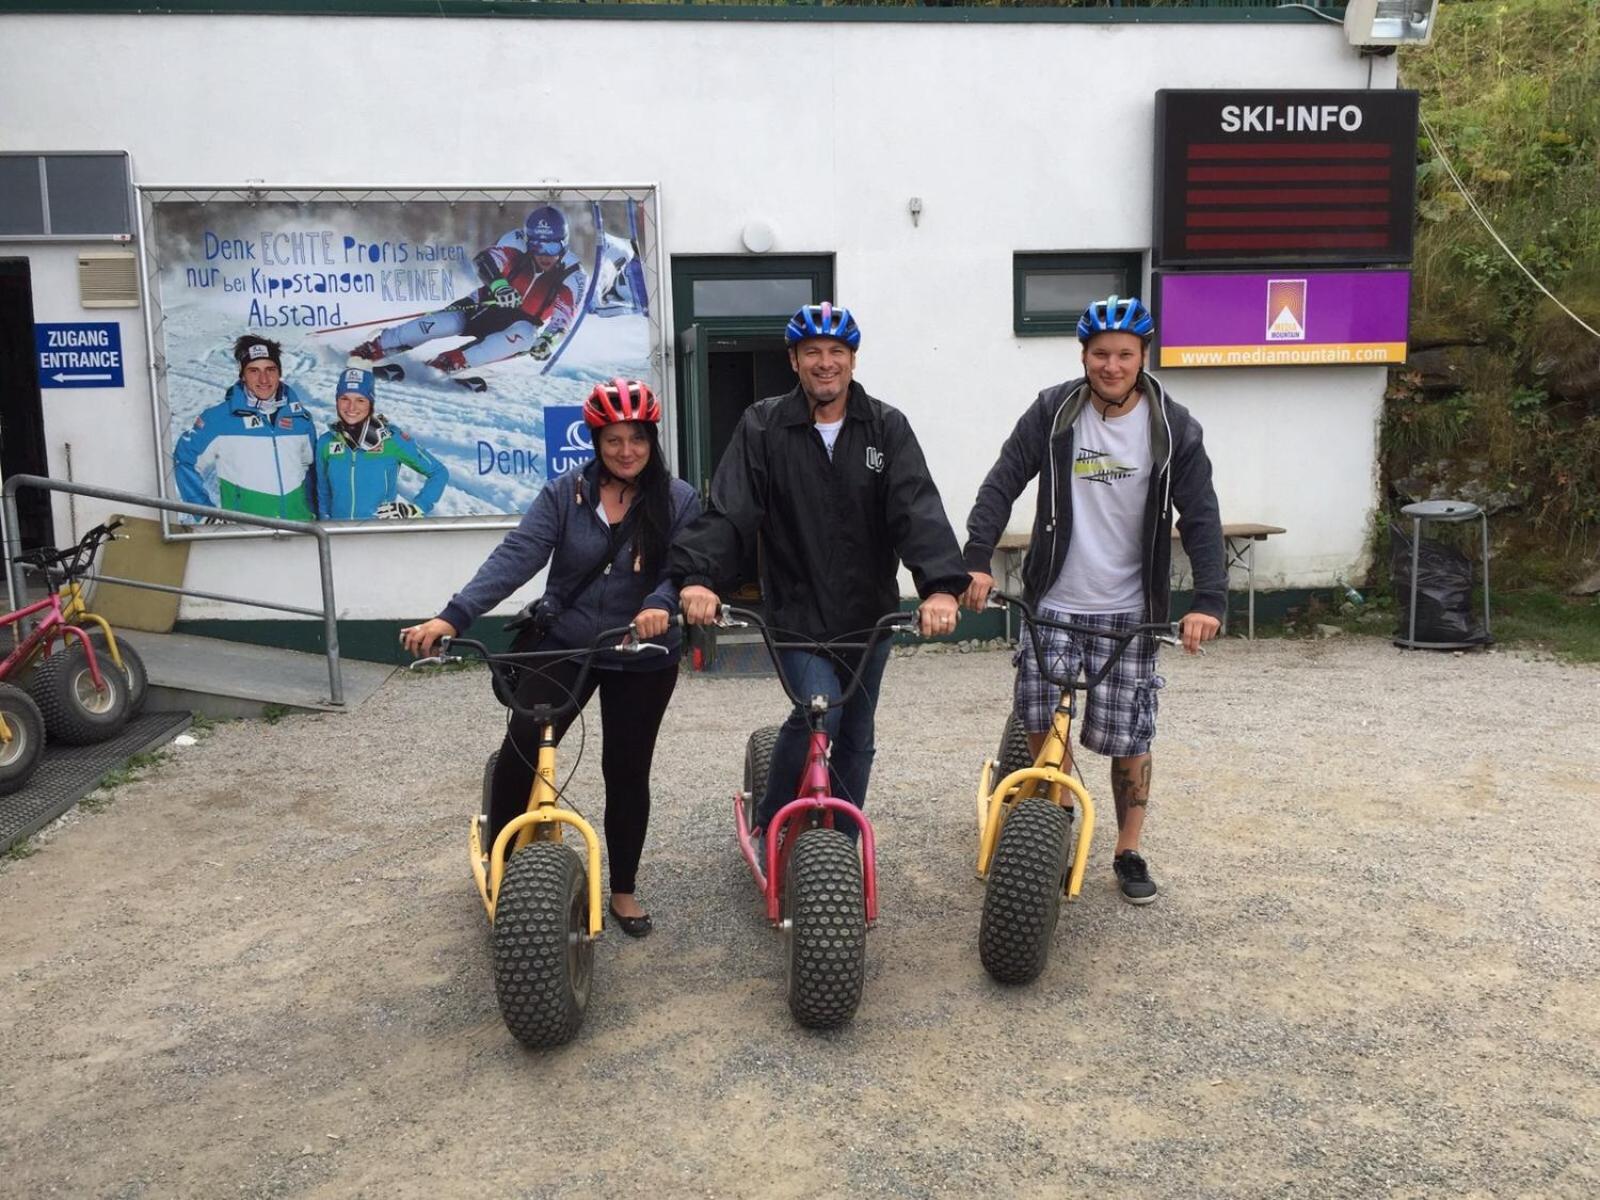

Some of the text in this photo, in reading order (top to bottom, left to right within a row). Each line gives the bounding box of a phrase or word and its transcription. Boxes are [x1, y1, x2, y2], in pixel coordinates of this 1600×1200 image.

[1220, 104, 1363, 133] SKI-INFO
[204, 230, 465, 266] Denk ECHTE Profis halten
[186, 267, 455, 301] nur bei Kippstangen KEINEN
[248, 298, 348, 327] Abstand.
[47, 329, 109, 348] ZUGANG
[40, 351, 120, 369] ENTRANCE
[1180, 347, 1388, 365] www.mediamountain.com
[477, 440, 589, 475] Denk UN
